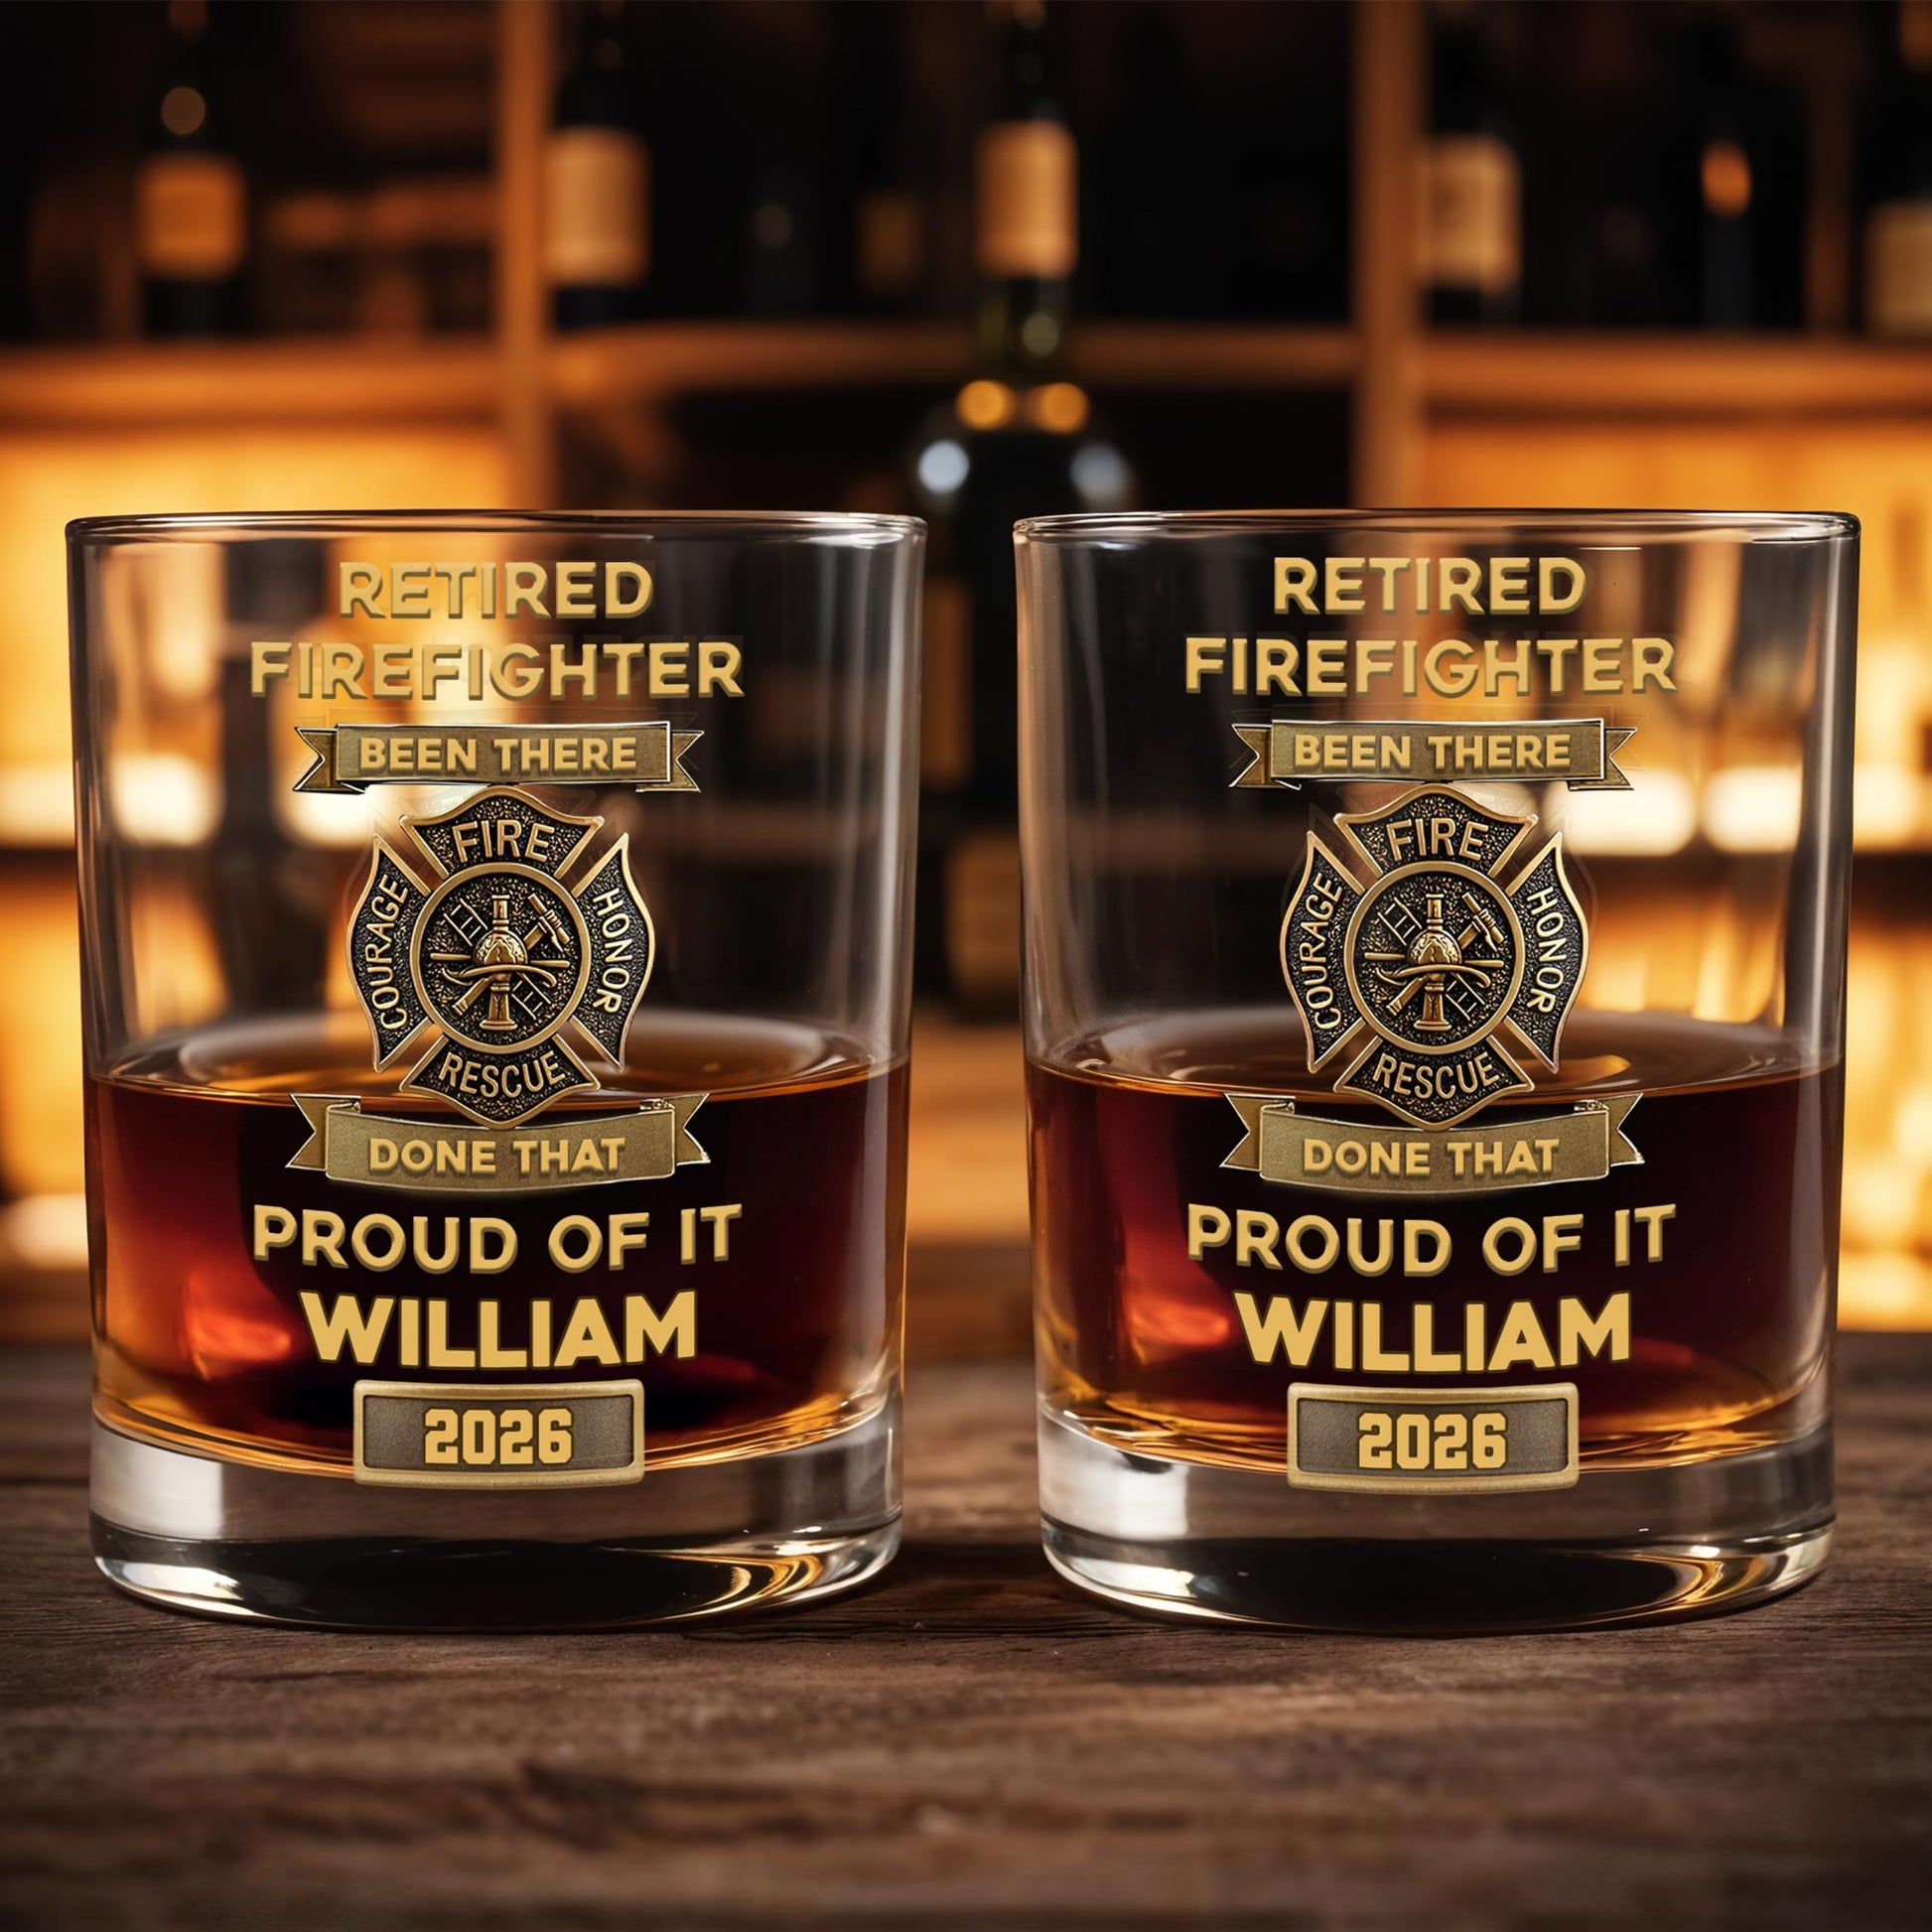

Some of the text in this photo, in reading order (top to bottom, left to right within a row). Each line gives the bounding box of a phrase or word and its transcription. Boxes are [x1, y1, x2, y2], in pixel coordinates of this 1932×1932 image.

[340, 561, 653, 619] RETIRED
[1274, 557, 1587, 616] RETIRED
[251, 641, 745, 701] FIREFIGHTER
[1184, 636, 1679, 698] FIREFIGHTER
[359, 737, 637, 772] BEEN THERE
[1294, 735, 1571, 771] BEEN THERE
[452, 819, 555, 863] FIRE
[1386, 817, 1489, 861] FIRE
[365, 875, 409, 1030] COURAGE
[592, 888, 632, 1014] HONOR
[1300, 873, 1342, 1030] COURAGE
[1526, 887, 1567, 1014] HONOR
[438, 1050, 566, 1098] RESCUE
[1372, 1051, 1500, 1099] RESCUE
[368, 1138, 626, 1174] DONE THAT
[1303, 1139, 1560, 1175] DONE THAT
[253, 1203, 743, 1275] PROUD OF IT
[1187, 1203, 1677, 1277] PROUD OF IT
[299, 1289, 698, 1369] WILLIAM
[1232, 1290, 1632, 1372] WILLIAM
[424, 1409, 573, 1466] 2026
[1357, 1413, 1507, 1471] 2026
